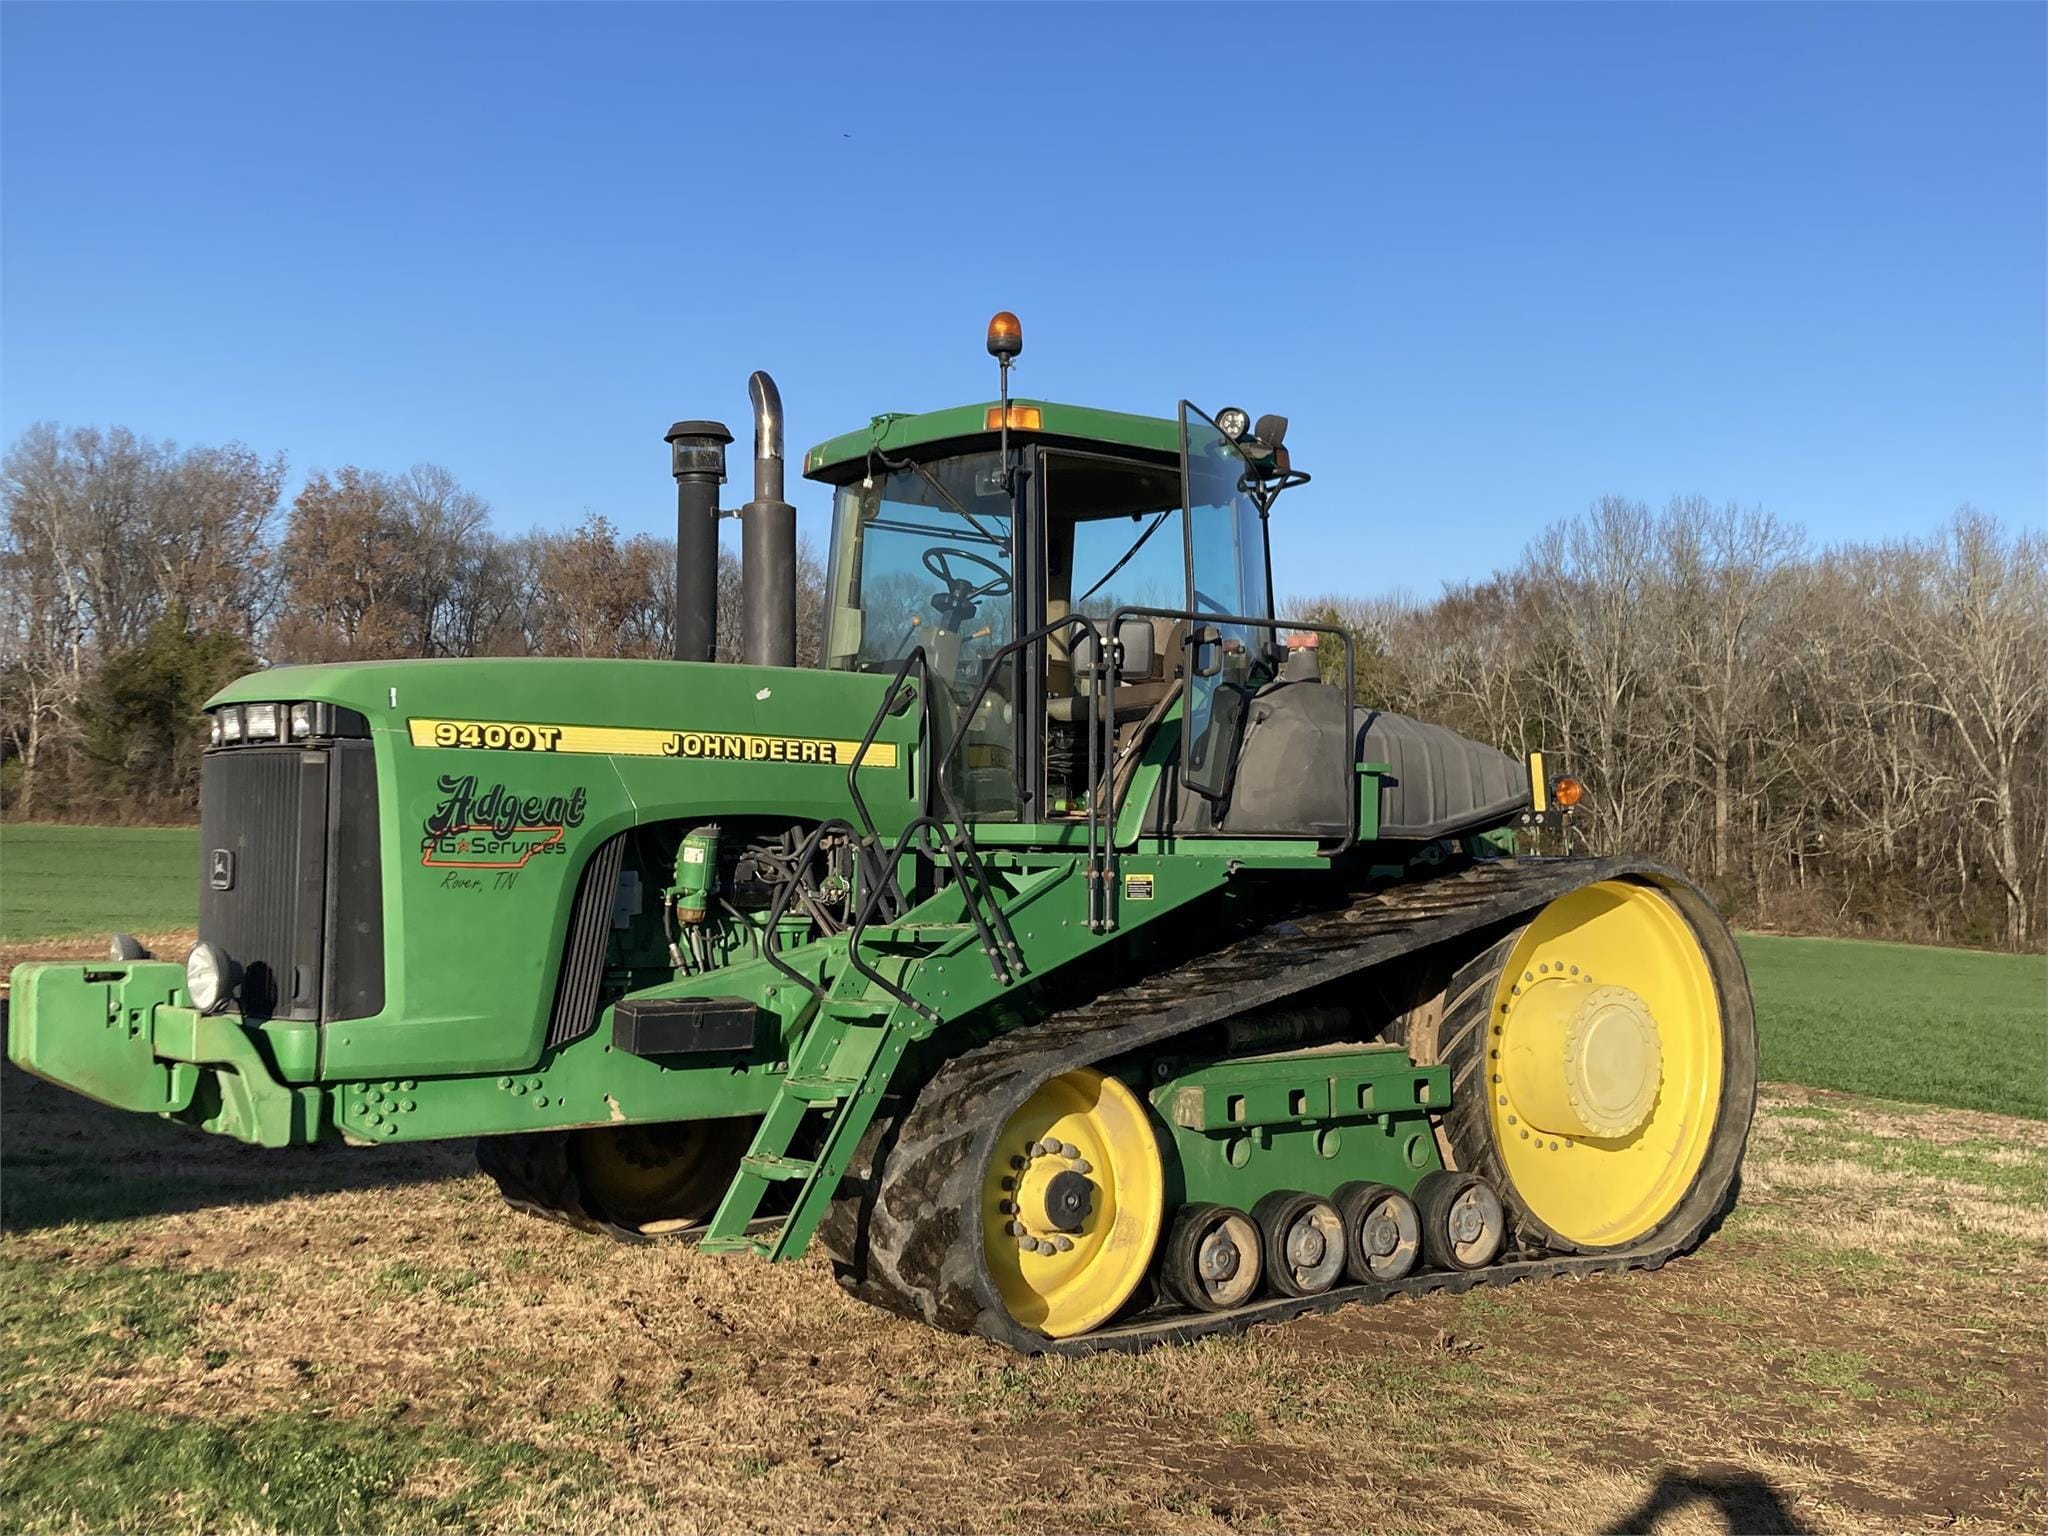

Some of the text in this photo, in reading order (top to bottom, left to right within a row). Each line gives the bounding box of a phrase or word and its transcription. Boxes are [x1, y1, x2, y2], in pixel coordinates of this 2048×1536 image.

[435, 723, 562, 751] 9400T
[662, 733, 838, 764] JOHN DEERE
[423, 775, 587, 841] Adgent
[471, 836, 567, 855] Services
[440, 871, 519, 893] Rover, TN
